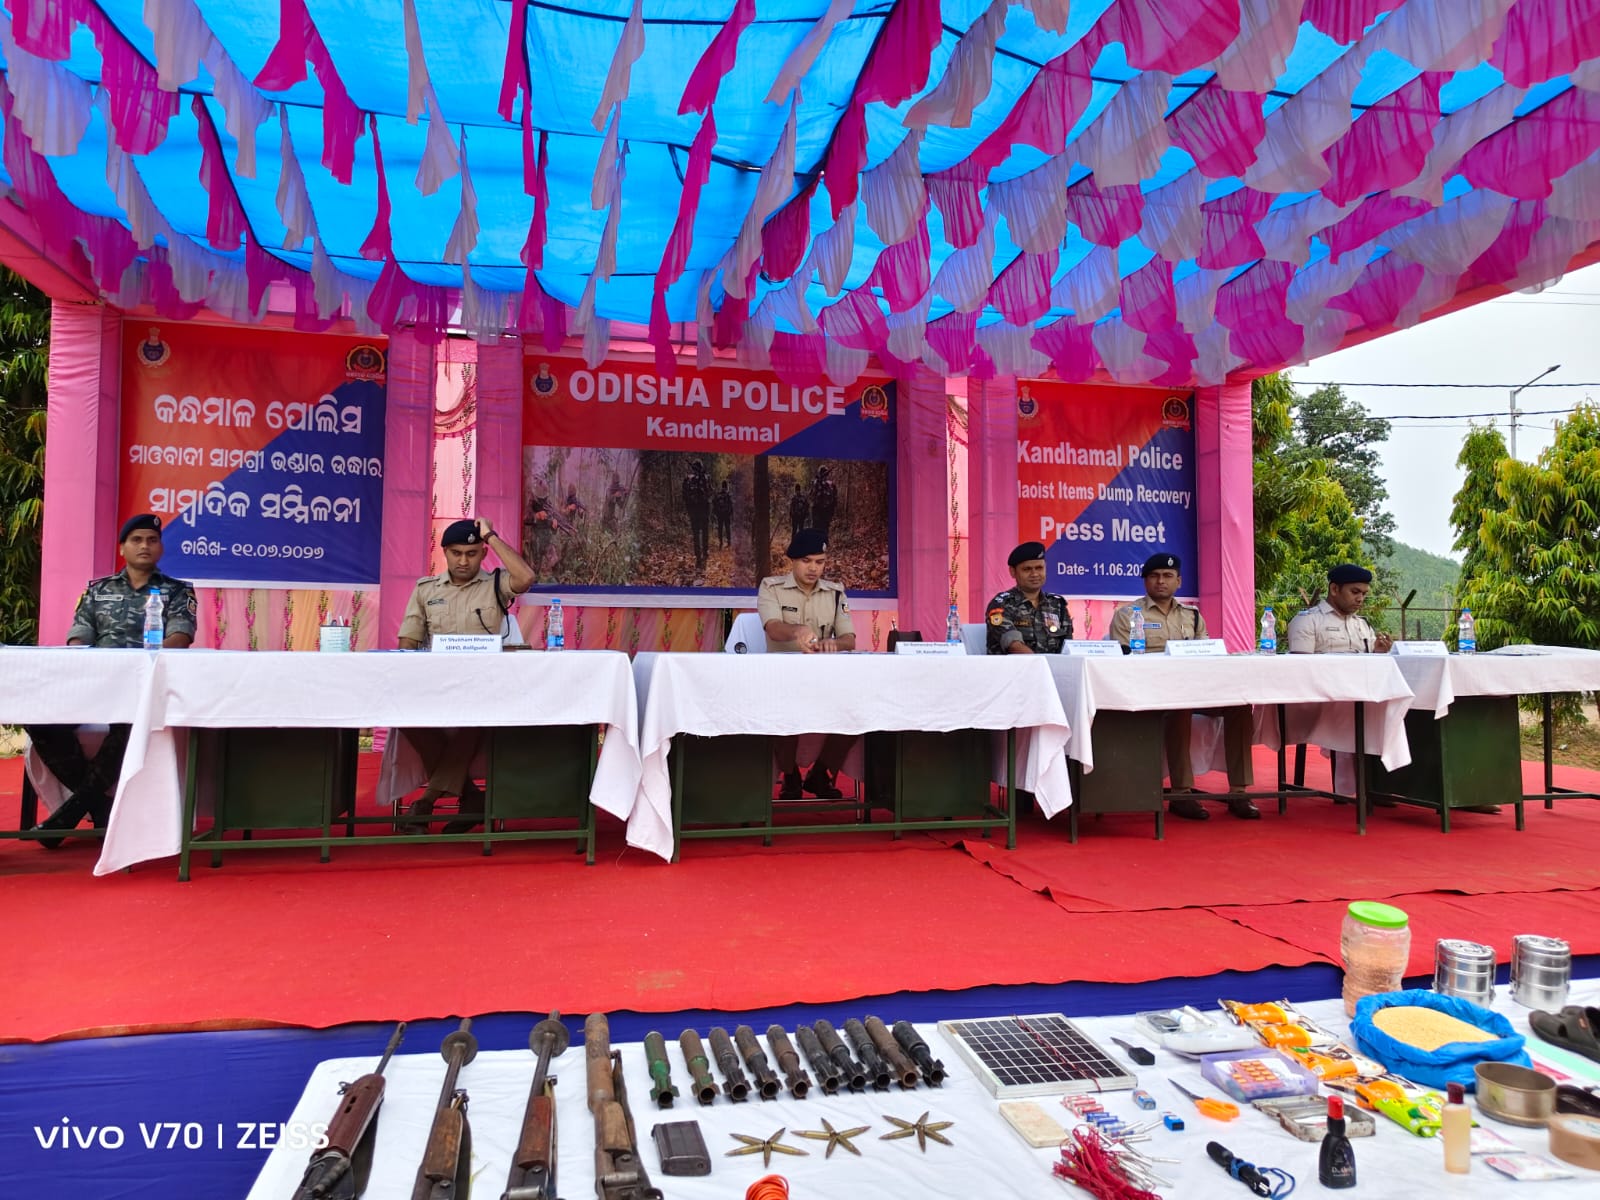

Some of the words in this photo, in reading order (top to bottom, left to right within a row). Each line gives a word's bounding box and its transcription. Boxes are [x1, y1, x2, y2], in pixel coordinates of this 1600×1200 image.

[569, 370, 710, 408] ODISHA
[721, 379, 845, 416] POLICE
[154, 394, 255, 428] କନ୍ଧମାଳ
[266, 394, 361, 434] ପୋଲିସ
[646, 416, 780, 442] Kandhamal
[1017, 439, 1122, 466] Kandhamal
[1128, 444, 1183, 470] Police
[1058, 480, 1095, 500] Items
[1097, 482, 1134, 507] Dump
[1137, 484, 1191, 509] Recovery
[1040, 516, 1105, 542] Press
[1112, 517, 1166, 544] Meet
[1057, 562, 1090, 577] Date-
